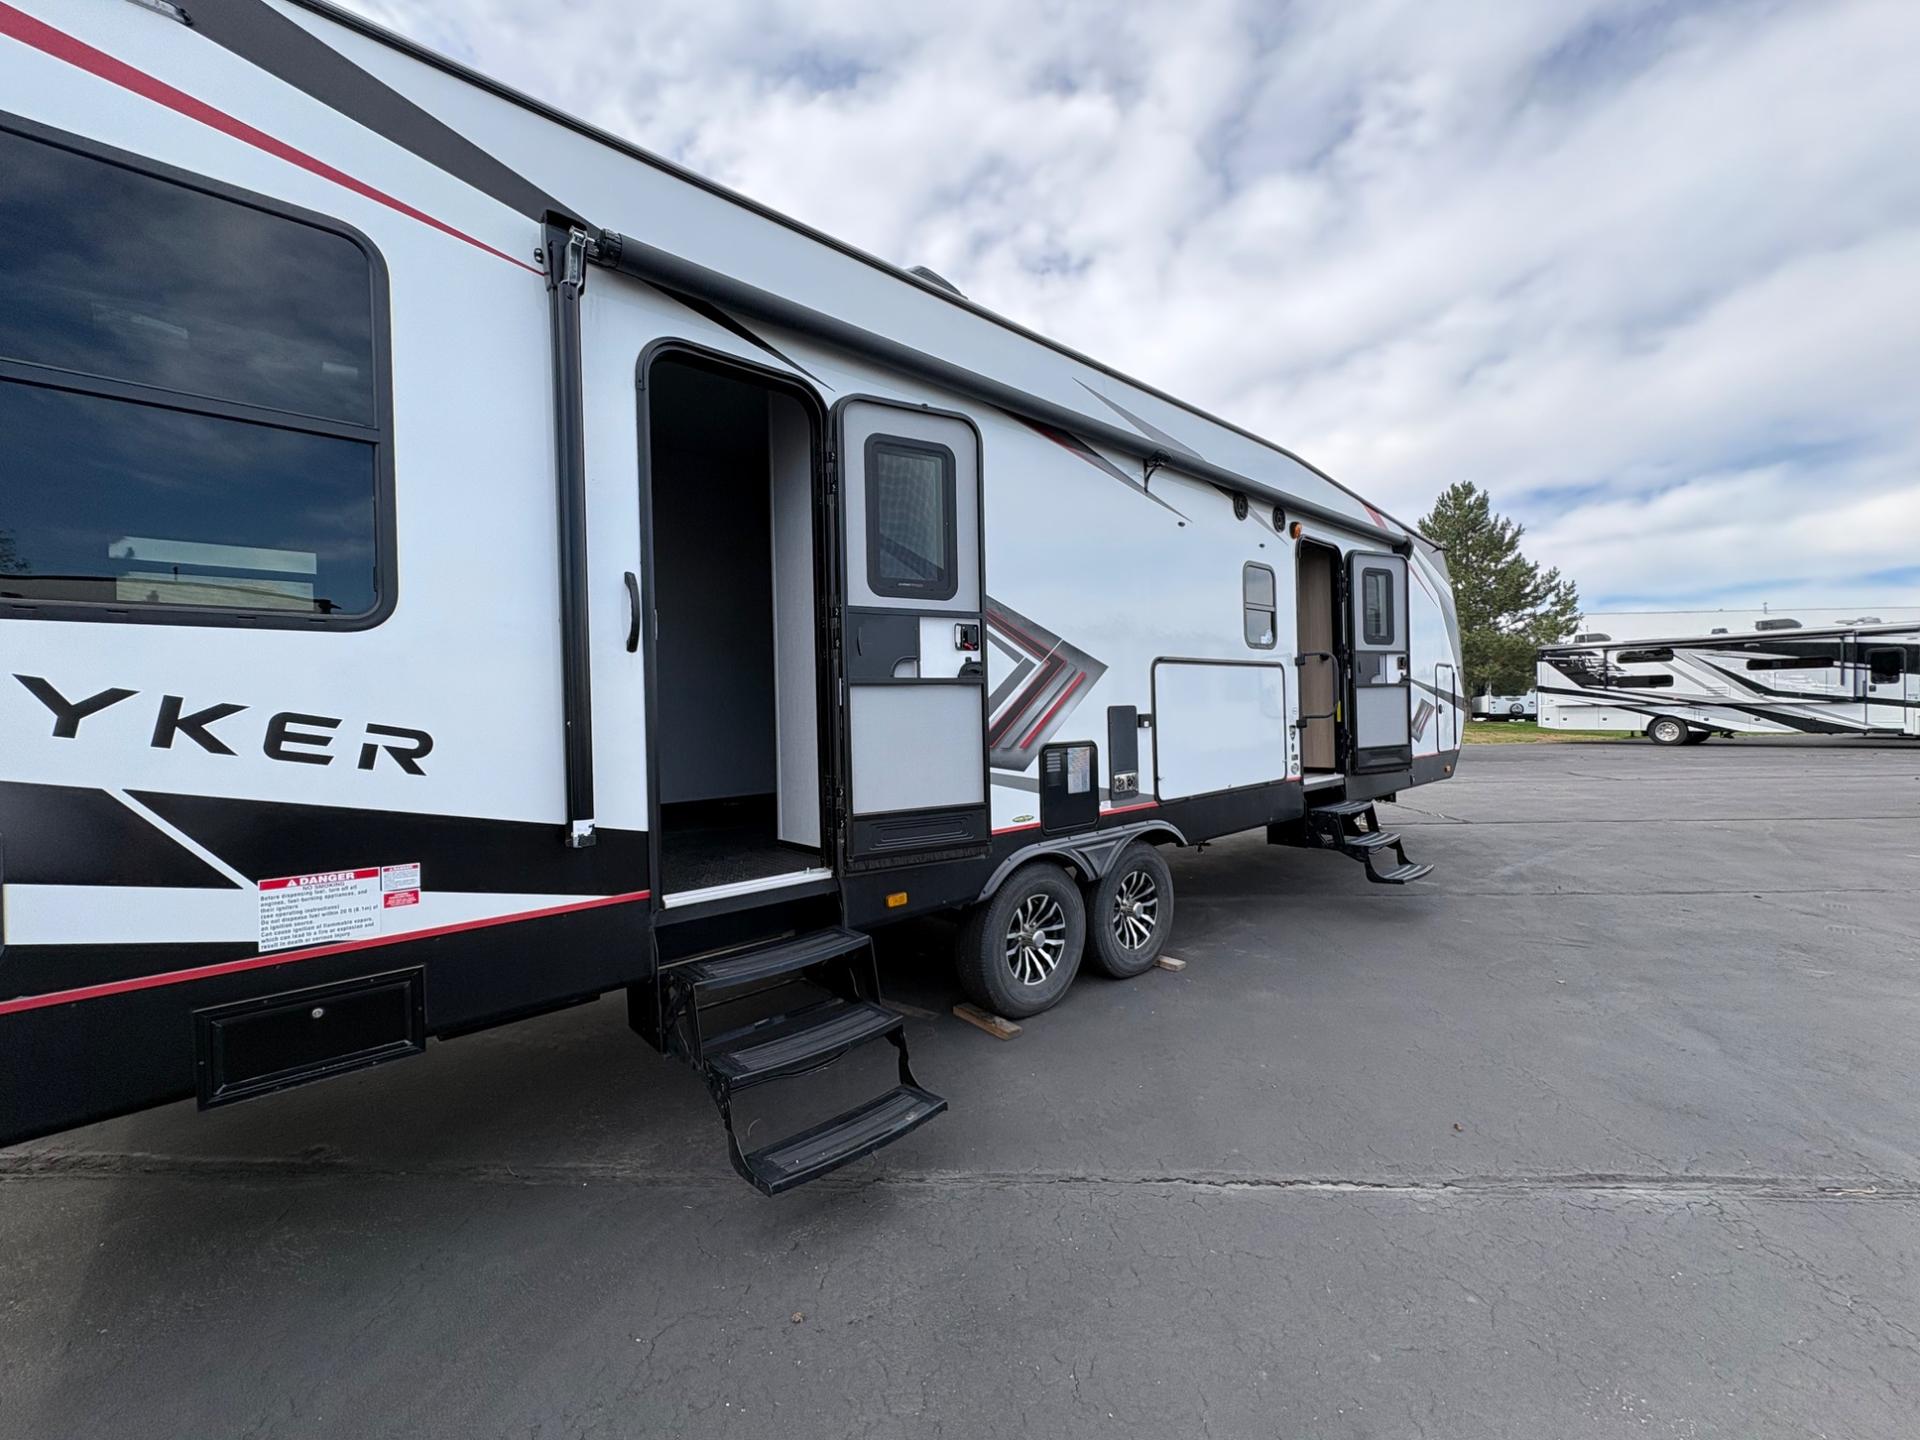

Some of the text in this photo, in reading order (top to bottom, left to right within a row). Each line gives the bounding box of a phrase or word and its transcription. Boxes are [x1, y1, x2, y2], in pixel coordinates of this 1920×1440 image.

[12, 673, 434, 777] YKER
[299, 872, 355, 886] DANGER
[282, 890, 313, 898] dispensing
